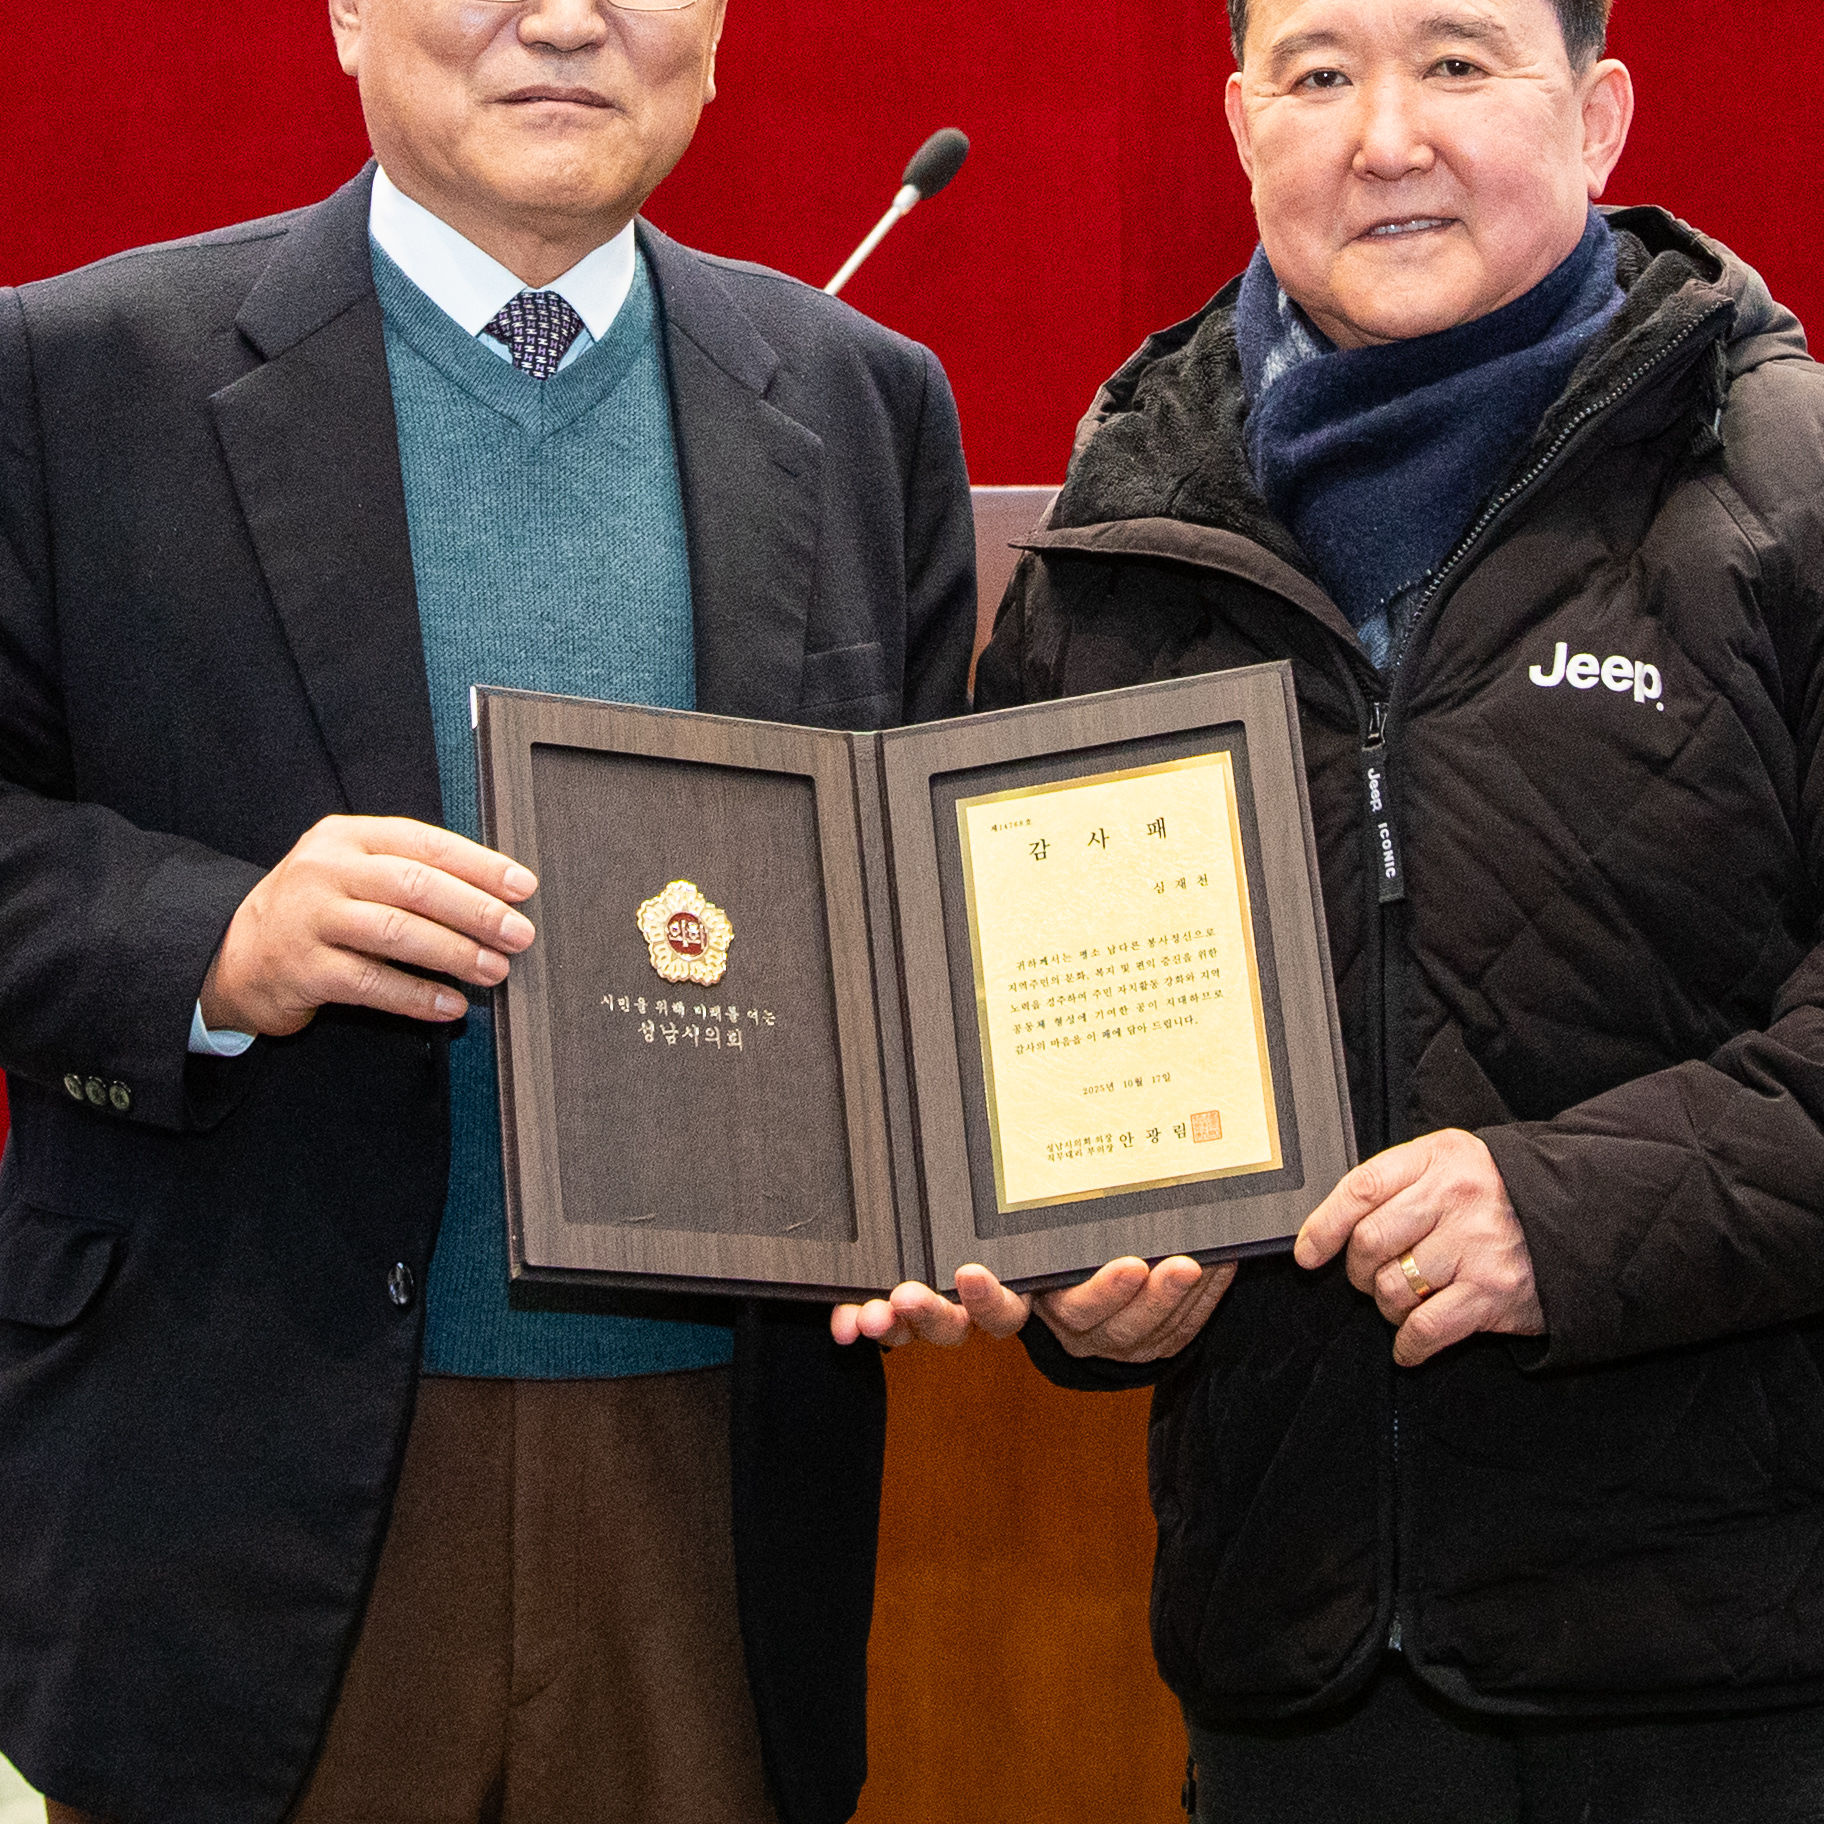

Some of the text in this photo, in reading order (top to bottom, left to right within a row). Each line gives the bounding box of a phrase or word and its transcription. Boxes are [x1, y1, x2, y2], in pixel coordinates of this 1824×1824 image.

[1377, 822, 1396, 879] ICONIC
[1107, 941, 1140, 955] 남다른
[1147, 928, 1216, 948] 봉사정신으로
[1008, 975, 1060, 992] 지역주민의
[1161, 952, 1192, 966] 증진을
[1198, 947, 1217, 960] 위한
[1092, 986, 1112, 999] 주민
[1117, 979, 1159, 994] 자치활동
[1164, 972, 1195, 987] 강화와
[1200, 968, 1220, 980] 지역
[600, 993, 776, 1026] 시민을 위해 미래를 여는
[1095, 1005, 1128, 1019] 기여한
[1136, 1000, 1158, 1013] 공이
[1167, 989, 1223, 1007] 지대하므로
[637, 1018, 743, 1052] 성남시의회
[1016, 1040, 1046, 1055] 감사의
[1050, 1034, 1082, 1048] 마음을
[1086, 1031, 1096, 1042] 이
[1127, 1022, 1147, 1036] 담아
[1152, 1015, 1198, 1031] 드립니다.
[1082, 1072, 1171, 1095] 2025년 10월 17일
[1046, 1133, 1113, 1153] 성남시의회 의장
[1047, 1143, 1114, 1162] 직무대리 부의장
